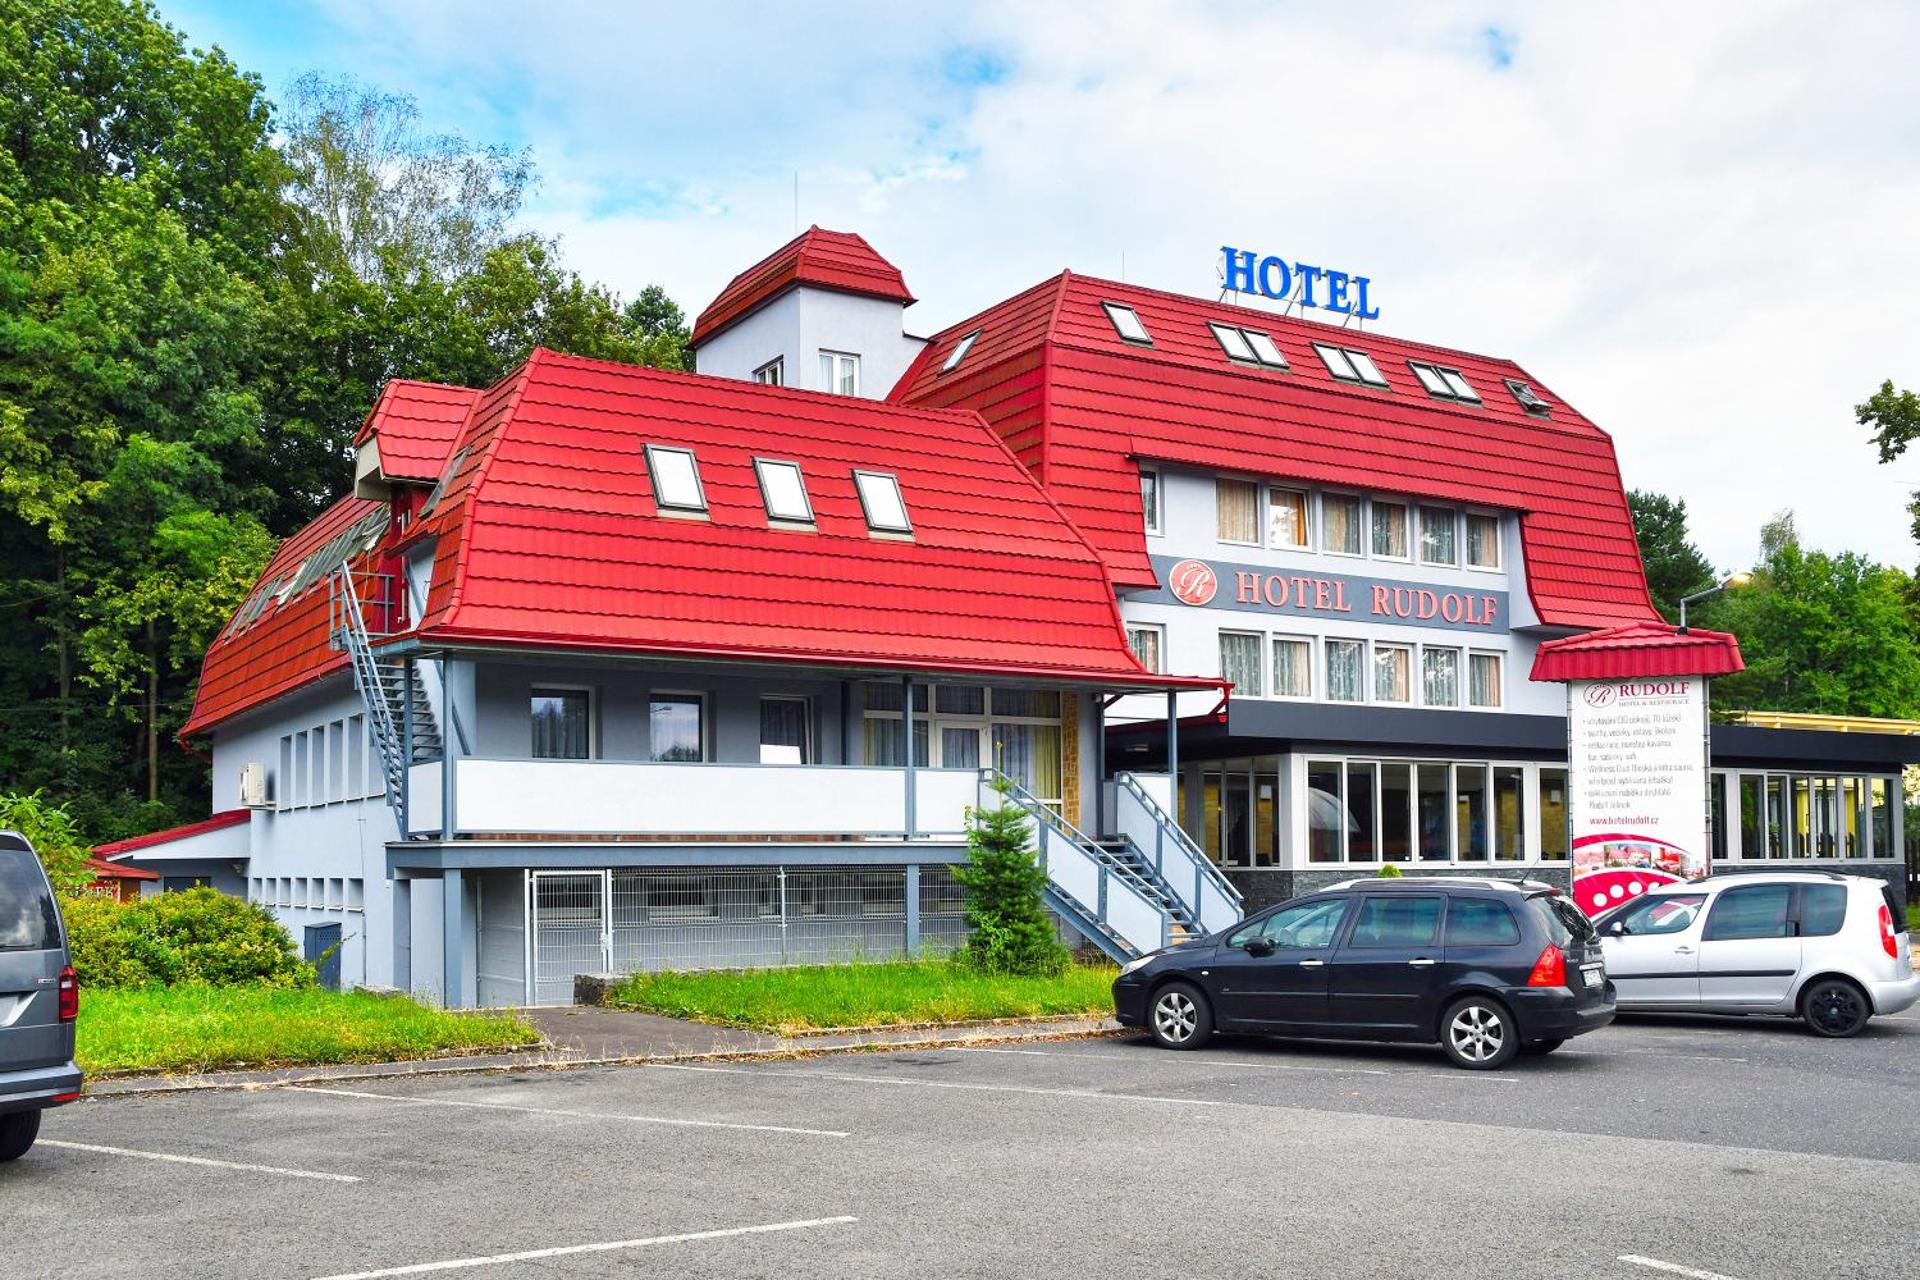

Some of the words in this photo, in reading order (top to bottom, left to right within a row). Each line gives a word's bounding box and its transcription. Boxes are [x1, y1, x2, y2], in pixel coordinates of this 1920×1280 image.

[1220, 246, 1380, 320] HOTEL
[1235, 571, 1352, 612] HOTEL
[1371, 584, 1498, 626] RUDOLF
[1620, 681, 1690, 697] RUDOLF
